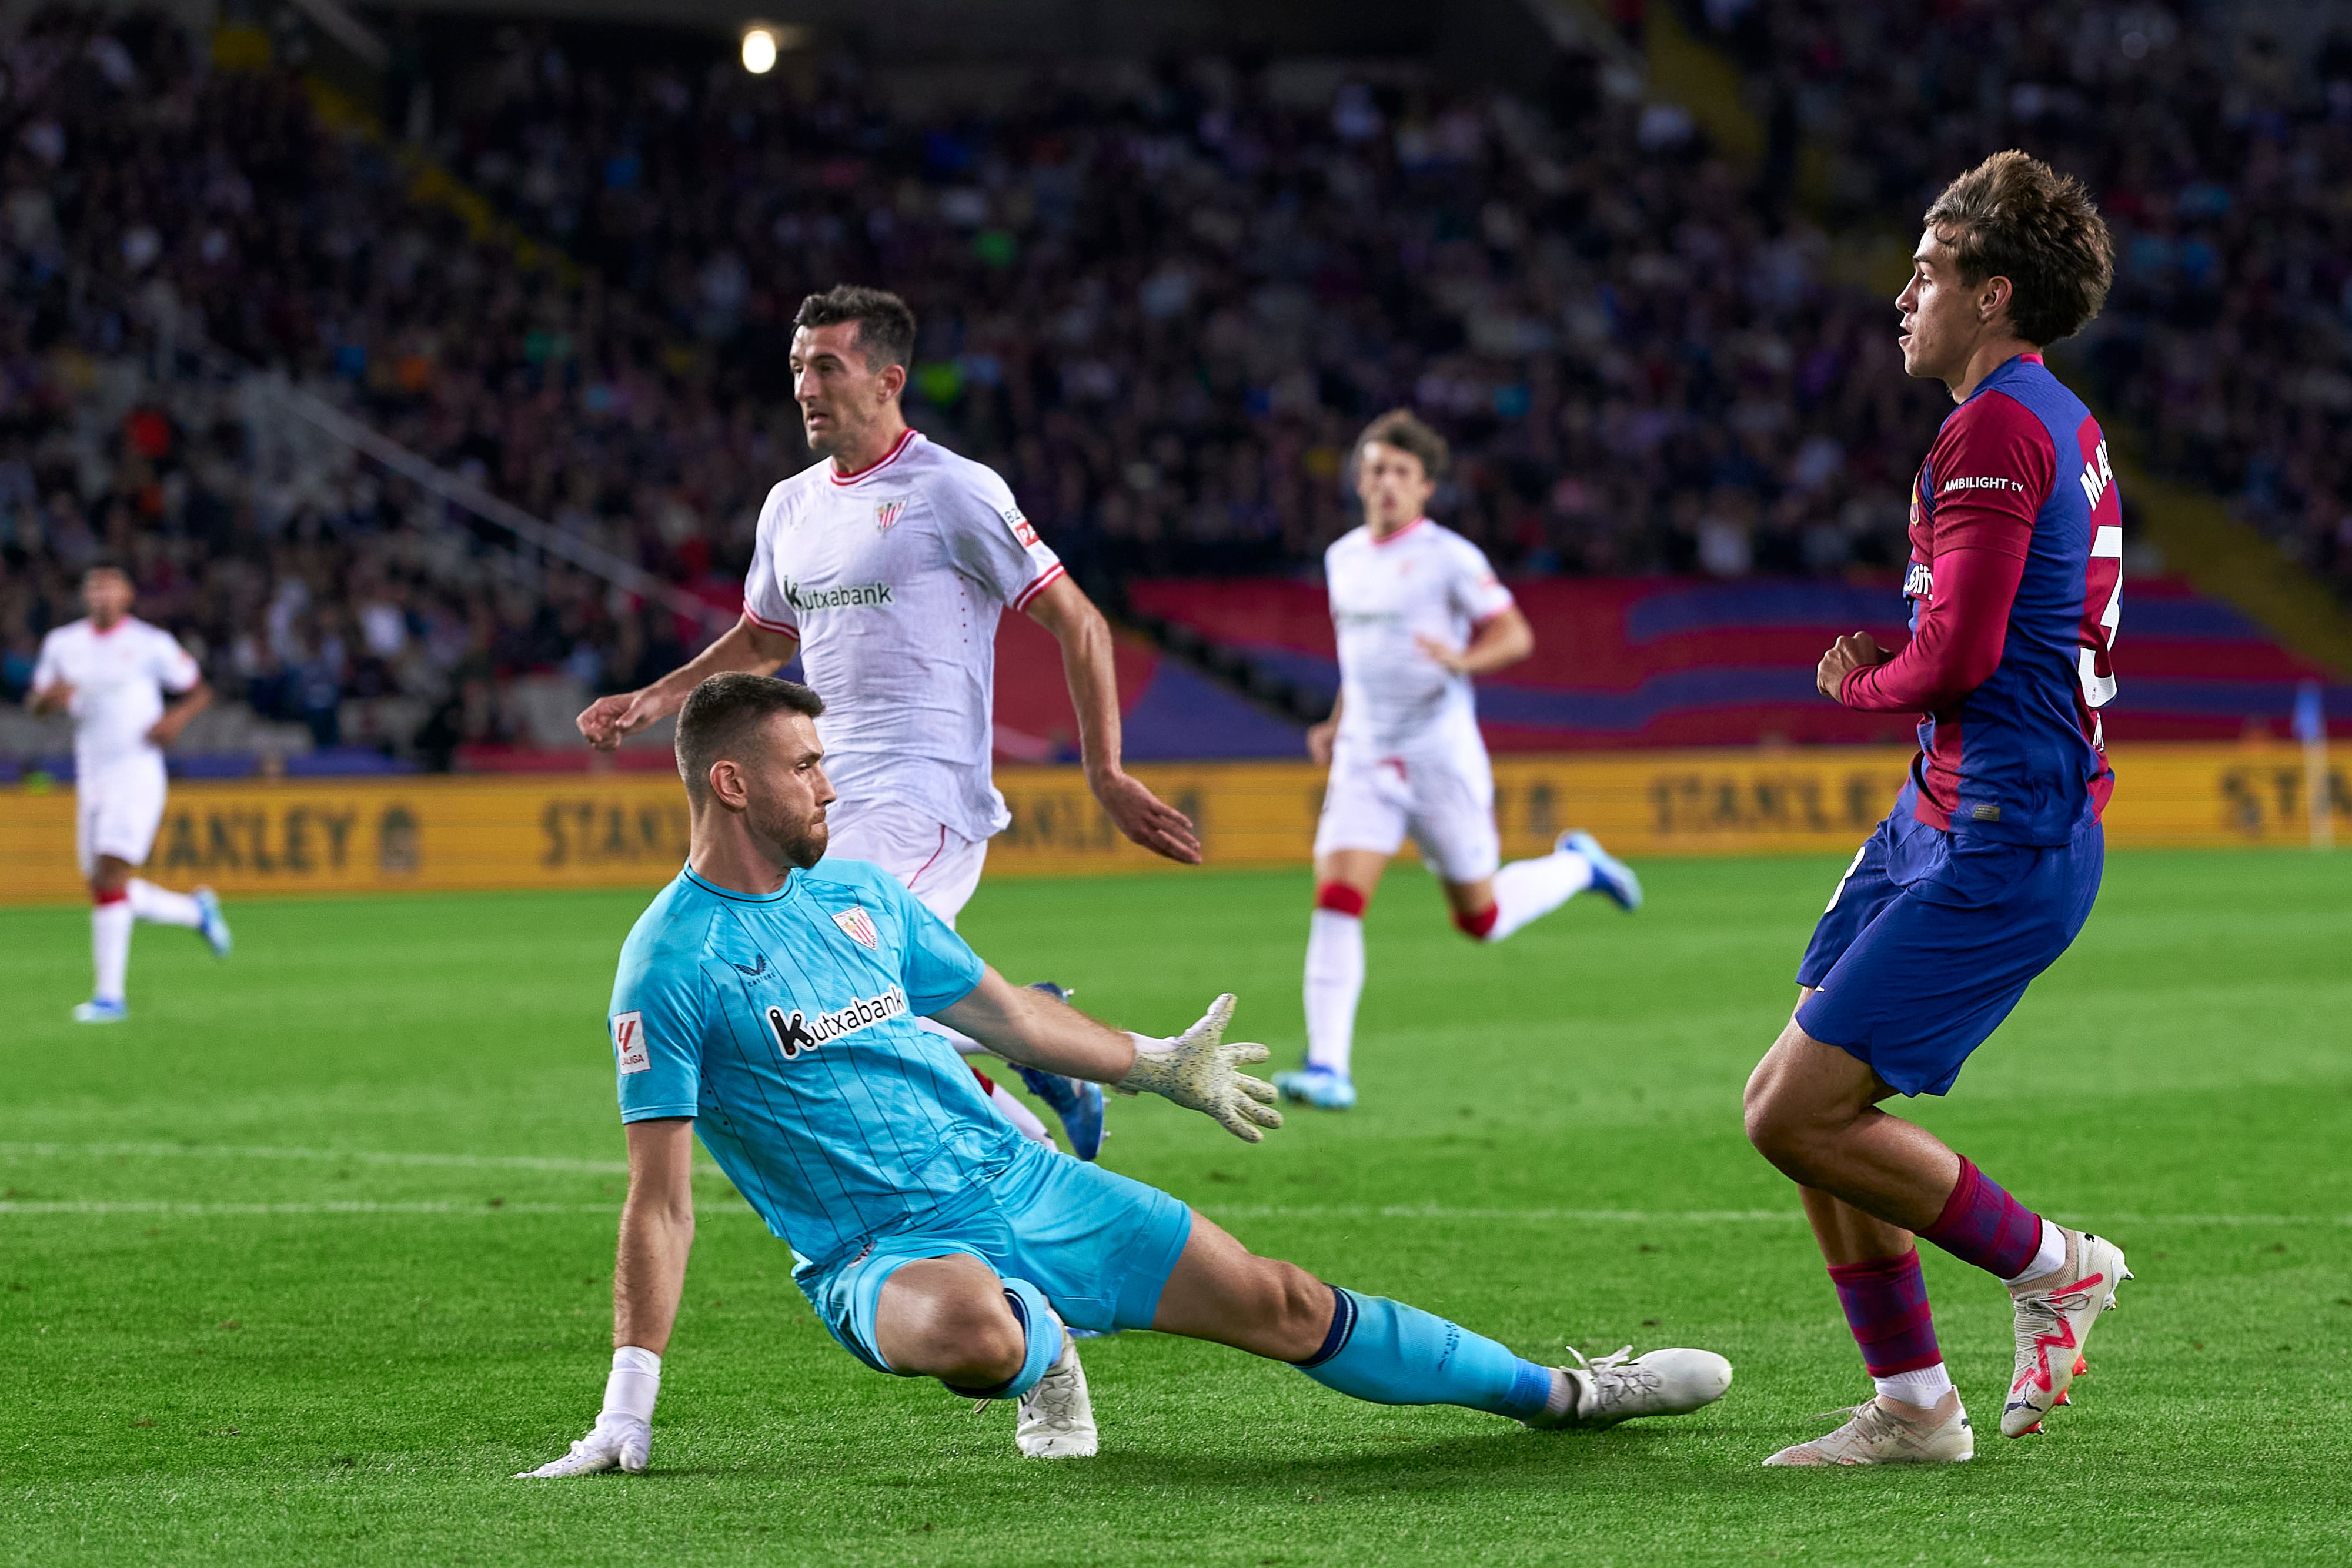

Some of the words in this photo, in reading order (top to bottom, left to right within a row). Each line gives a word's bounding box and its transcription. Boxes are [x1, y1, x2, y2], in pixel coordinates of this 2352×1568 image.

[1943, 476, 2009, 493] AMBILIGHT
[2011, 480, 2024, 493] tv
[2080, 439, 2113, 511] MA
[784, 574, 893, 610] Kutxabank
[144, 805, 358, 872] ANLEY
[770, 987, 904, 1056] Kutxabank
